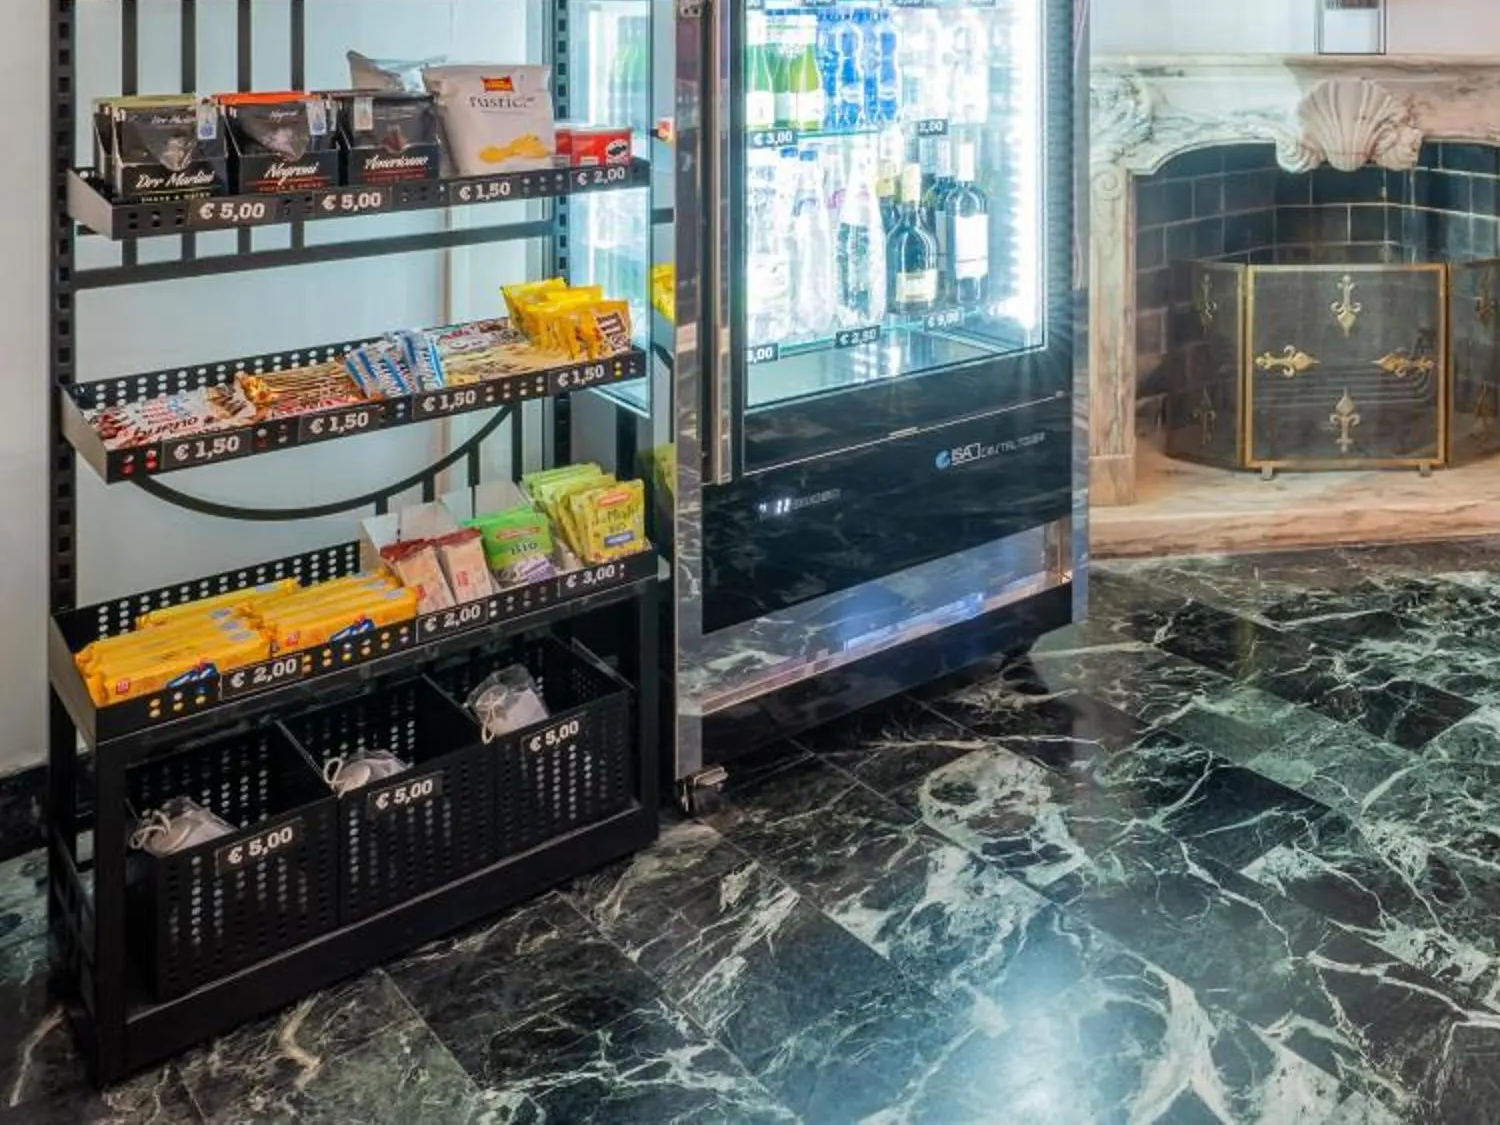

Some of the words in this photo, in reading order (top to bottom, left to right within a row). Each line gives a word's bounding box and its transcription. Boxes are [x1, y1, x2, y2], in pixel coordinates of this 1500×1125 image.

[753, 132, 763, 146] €
[577, 173, 588, 186] €
[594, 167, 625, 183] 2,00
[322, 194, 335, 210] €
[341, 192, 381, 211] 5,00
[459, 187, 471, 200] €
[476, 182, 511, 200] 1,50
[200, 204, 213, 219] €
[219, 202, 265, 222] 5,00
[839, 335, 850, 345] €
[557, 373, 570, 387] €
[572, 364, 604, 385] 1,50
[422, 397, 435, 412] €
[439, 390, 477, 411] 1,50
[309, 418, 324, 435] €
[330, 411, 369, 432] 1,50
[173, 444, 189, 461] €
[195, 435, 241, 460] 1,50
[565, 574, 577, 588] €
[582, 563, 616, 585] 3,00
[424, 617, 437, 632] €
[443, 604, 481, 627] 2,00
[231, 673, 245, 688] €
[252, 658, 297, 679] 2,00
[529, 736, 542, 752] €
[546, 720, 579, 746] 5,00
[375, 792, 389, 810] €
[394, 779, 433, 805] 5,00
[227, 847, 242, 864] €
[248, 826, 293, 856] 5,00
